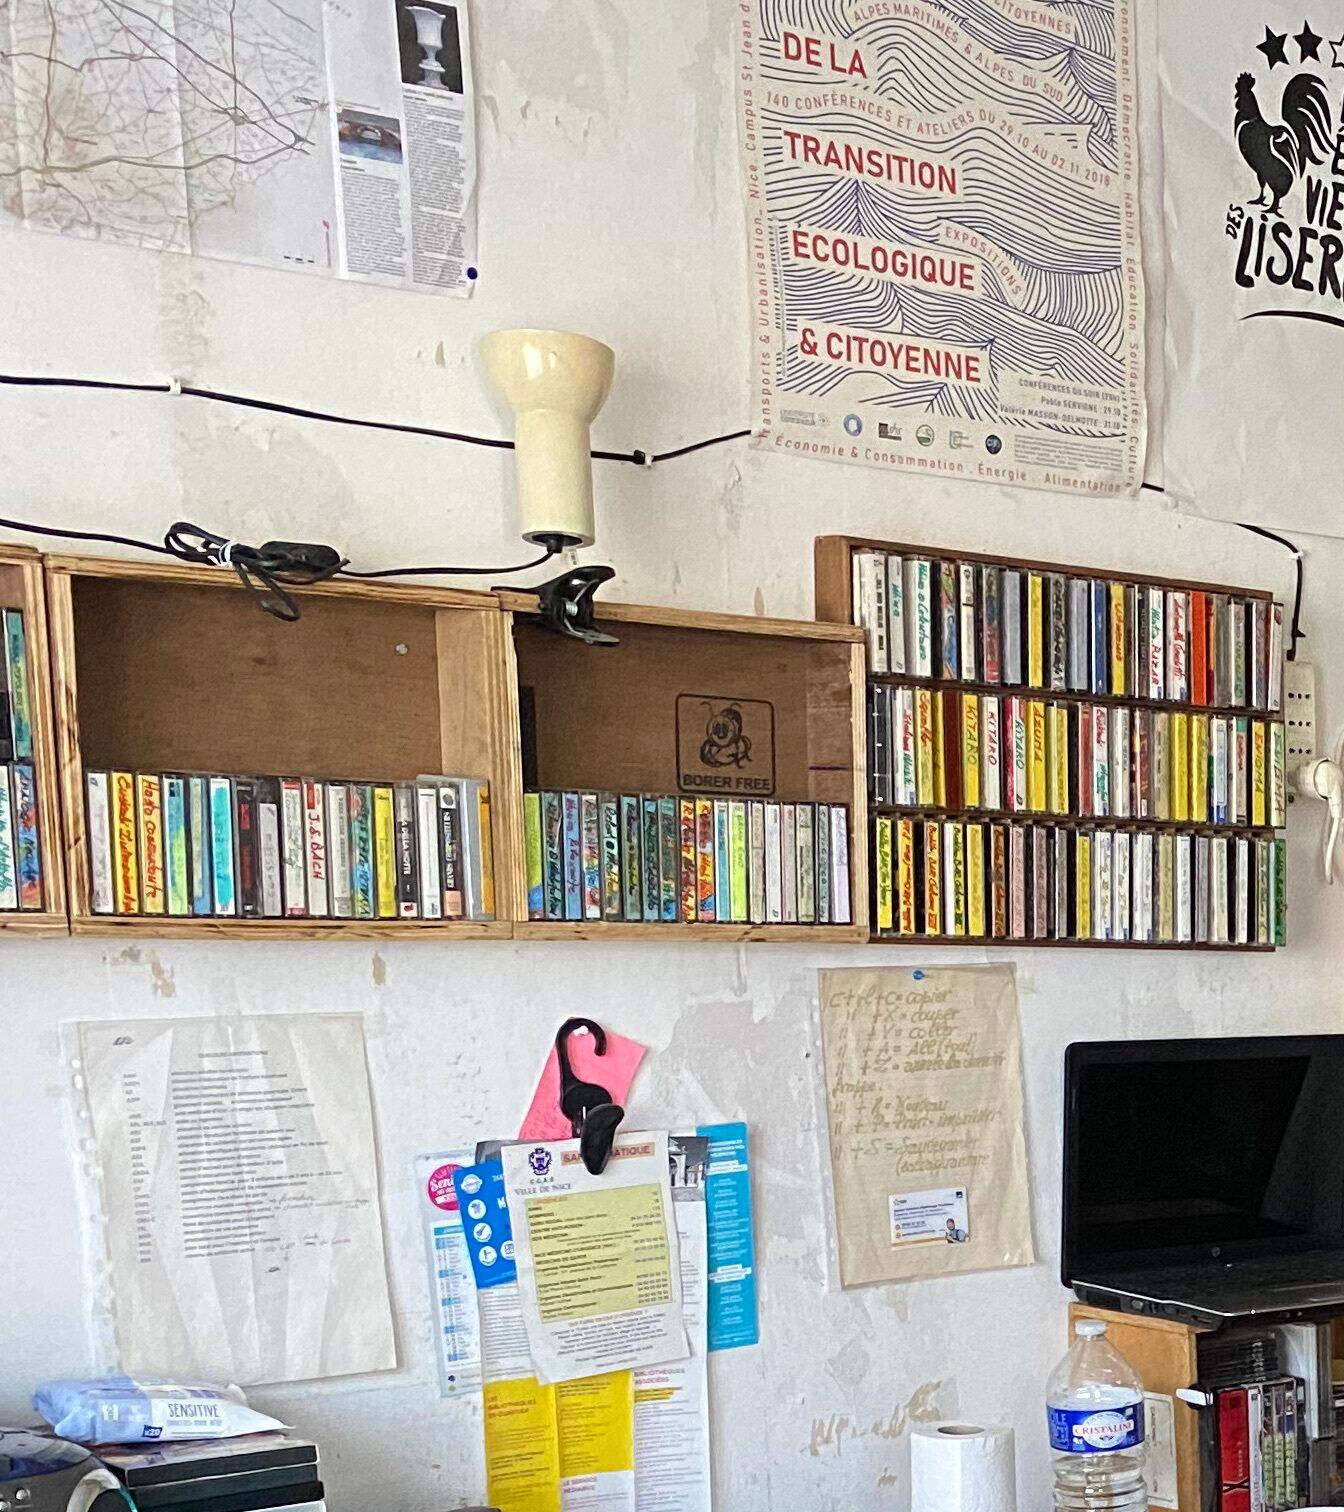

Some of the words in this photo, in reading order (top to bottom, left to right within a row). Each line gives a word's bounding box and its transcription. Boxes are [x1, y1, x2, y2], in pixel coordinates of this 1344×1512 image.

[995, 0, 1072, 34] TOYENNES
[783, 31, 822, 66] DE
[829, 41, 868, 80] LA
[854, 5, 889, 23] ALPES
[893, 3, 958, 44] MARITIMES
[964, 43, 973, 55] &
[974, 49, 1015, 82] ALPES
[1022, 72, 1036, 88] DU
[1042, 81, 1064, 102] SUD
[767, 91, 789, 108] 140
[794, 88, 892, 123] CONFÉRENCES
[897, 111, 912, 128] ET
[917, 109, 975, 137] ATELIERS
[979, 106, 996, 122] DU
[1032, 143, 1049, 159] AU
[784, 131, 958, 194] TRANSITION
[1226, 204, 1245, 239] DES
[944, 228, 1022, 296] EXPOSITIONS
[800, 328, 818, 356] &
[826, 334, 982, 383] CITOYENNE
[775, 434, 845, 457] Économie
[851, 446, 860, 458] &
[864, 447, 964, 473] Consommation
[977, 458, 1027, 481] Énergie
[1044, 473, 1121, 492] Alimentation
[967, 705, 979, 765] KITARO
[988, 711, 999, 766] KITARO
[1015, 719, 1026, 770] KITARO
[683, 774, 732, 788] BORER
[735, 777, 771, 790] FREE
[614, 1144, 652, 1158] ATIQUE
[514, 1186, 537, 1196] VILLE
[539, 1185, 549, 1194] DE
[551, 1182, 572, 1193] NICE
[168, 1403, 220, 1418] SENSITIVE
[1074, 1420, 1133, 1435] CRISTALINE
